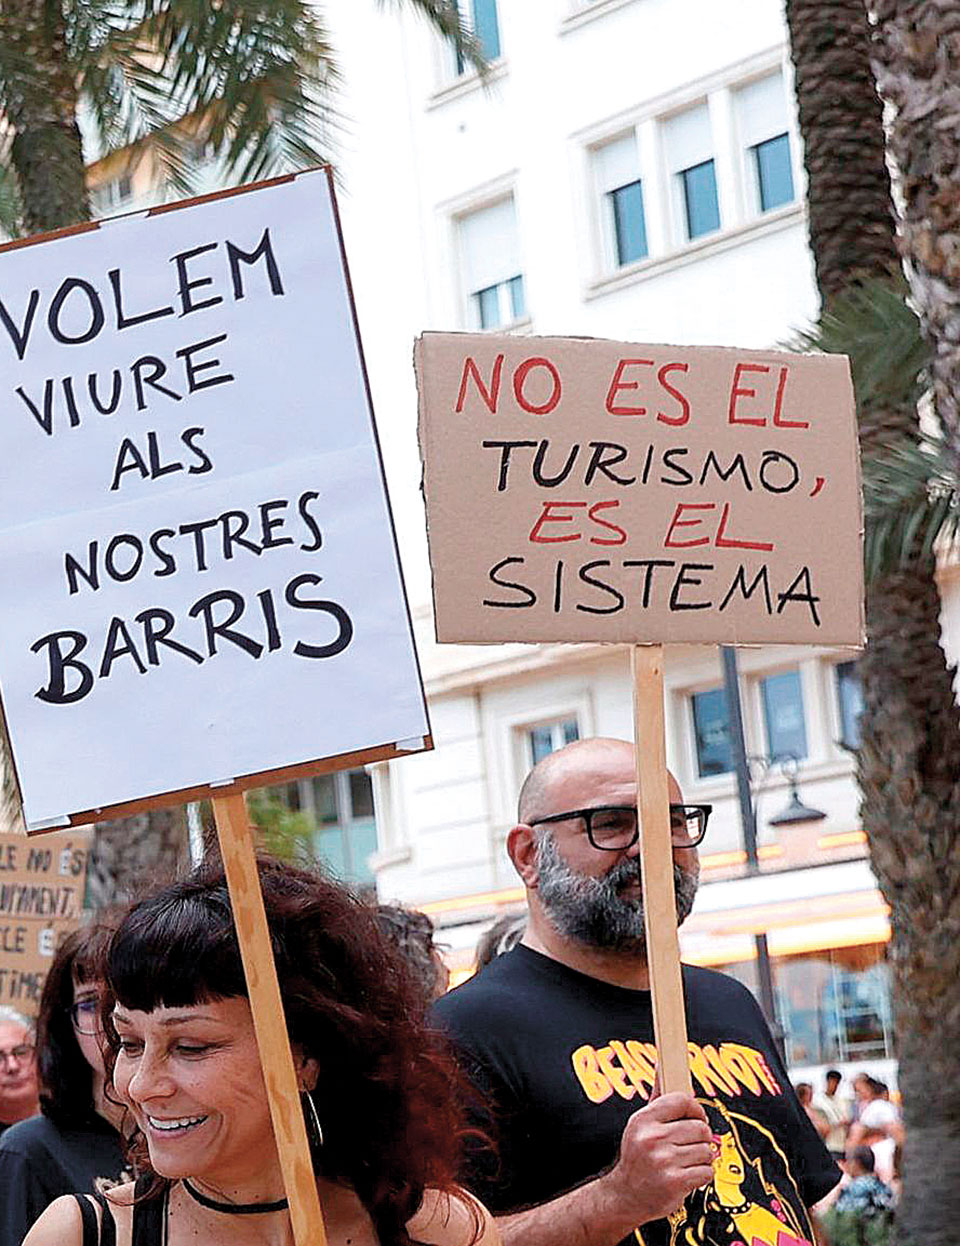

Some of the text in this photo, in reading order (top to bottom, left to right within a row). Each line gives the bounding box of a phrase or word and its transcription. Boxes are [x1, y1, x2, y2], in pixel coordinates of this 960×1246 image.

[16, 334, 234, 435] VIURE
[455, 354, 809, 429] NO ES EL
[110, 427, 212, 490] ALS
[482, 440, 825, 496] TURISMO,
[65, 492, 323, 595] NOSTRES
[529, 501, 774, 551] ES EL
[483, 557, 821, 626] SISTEMA
[31, 573, 353, 704] BARRIS
